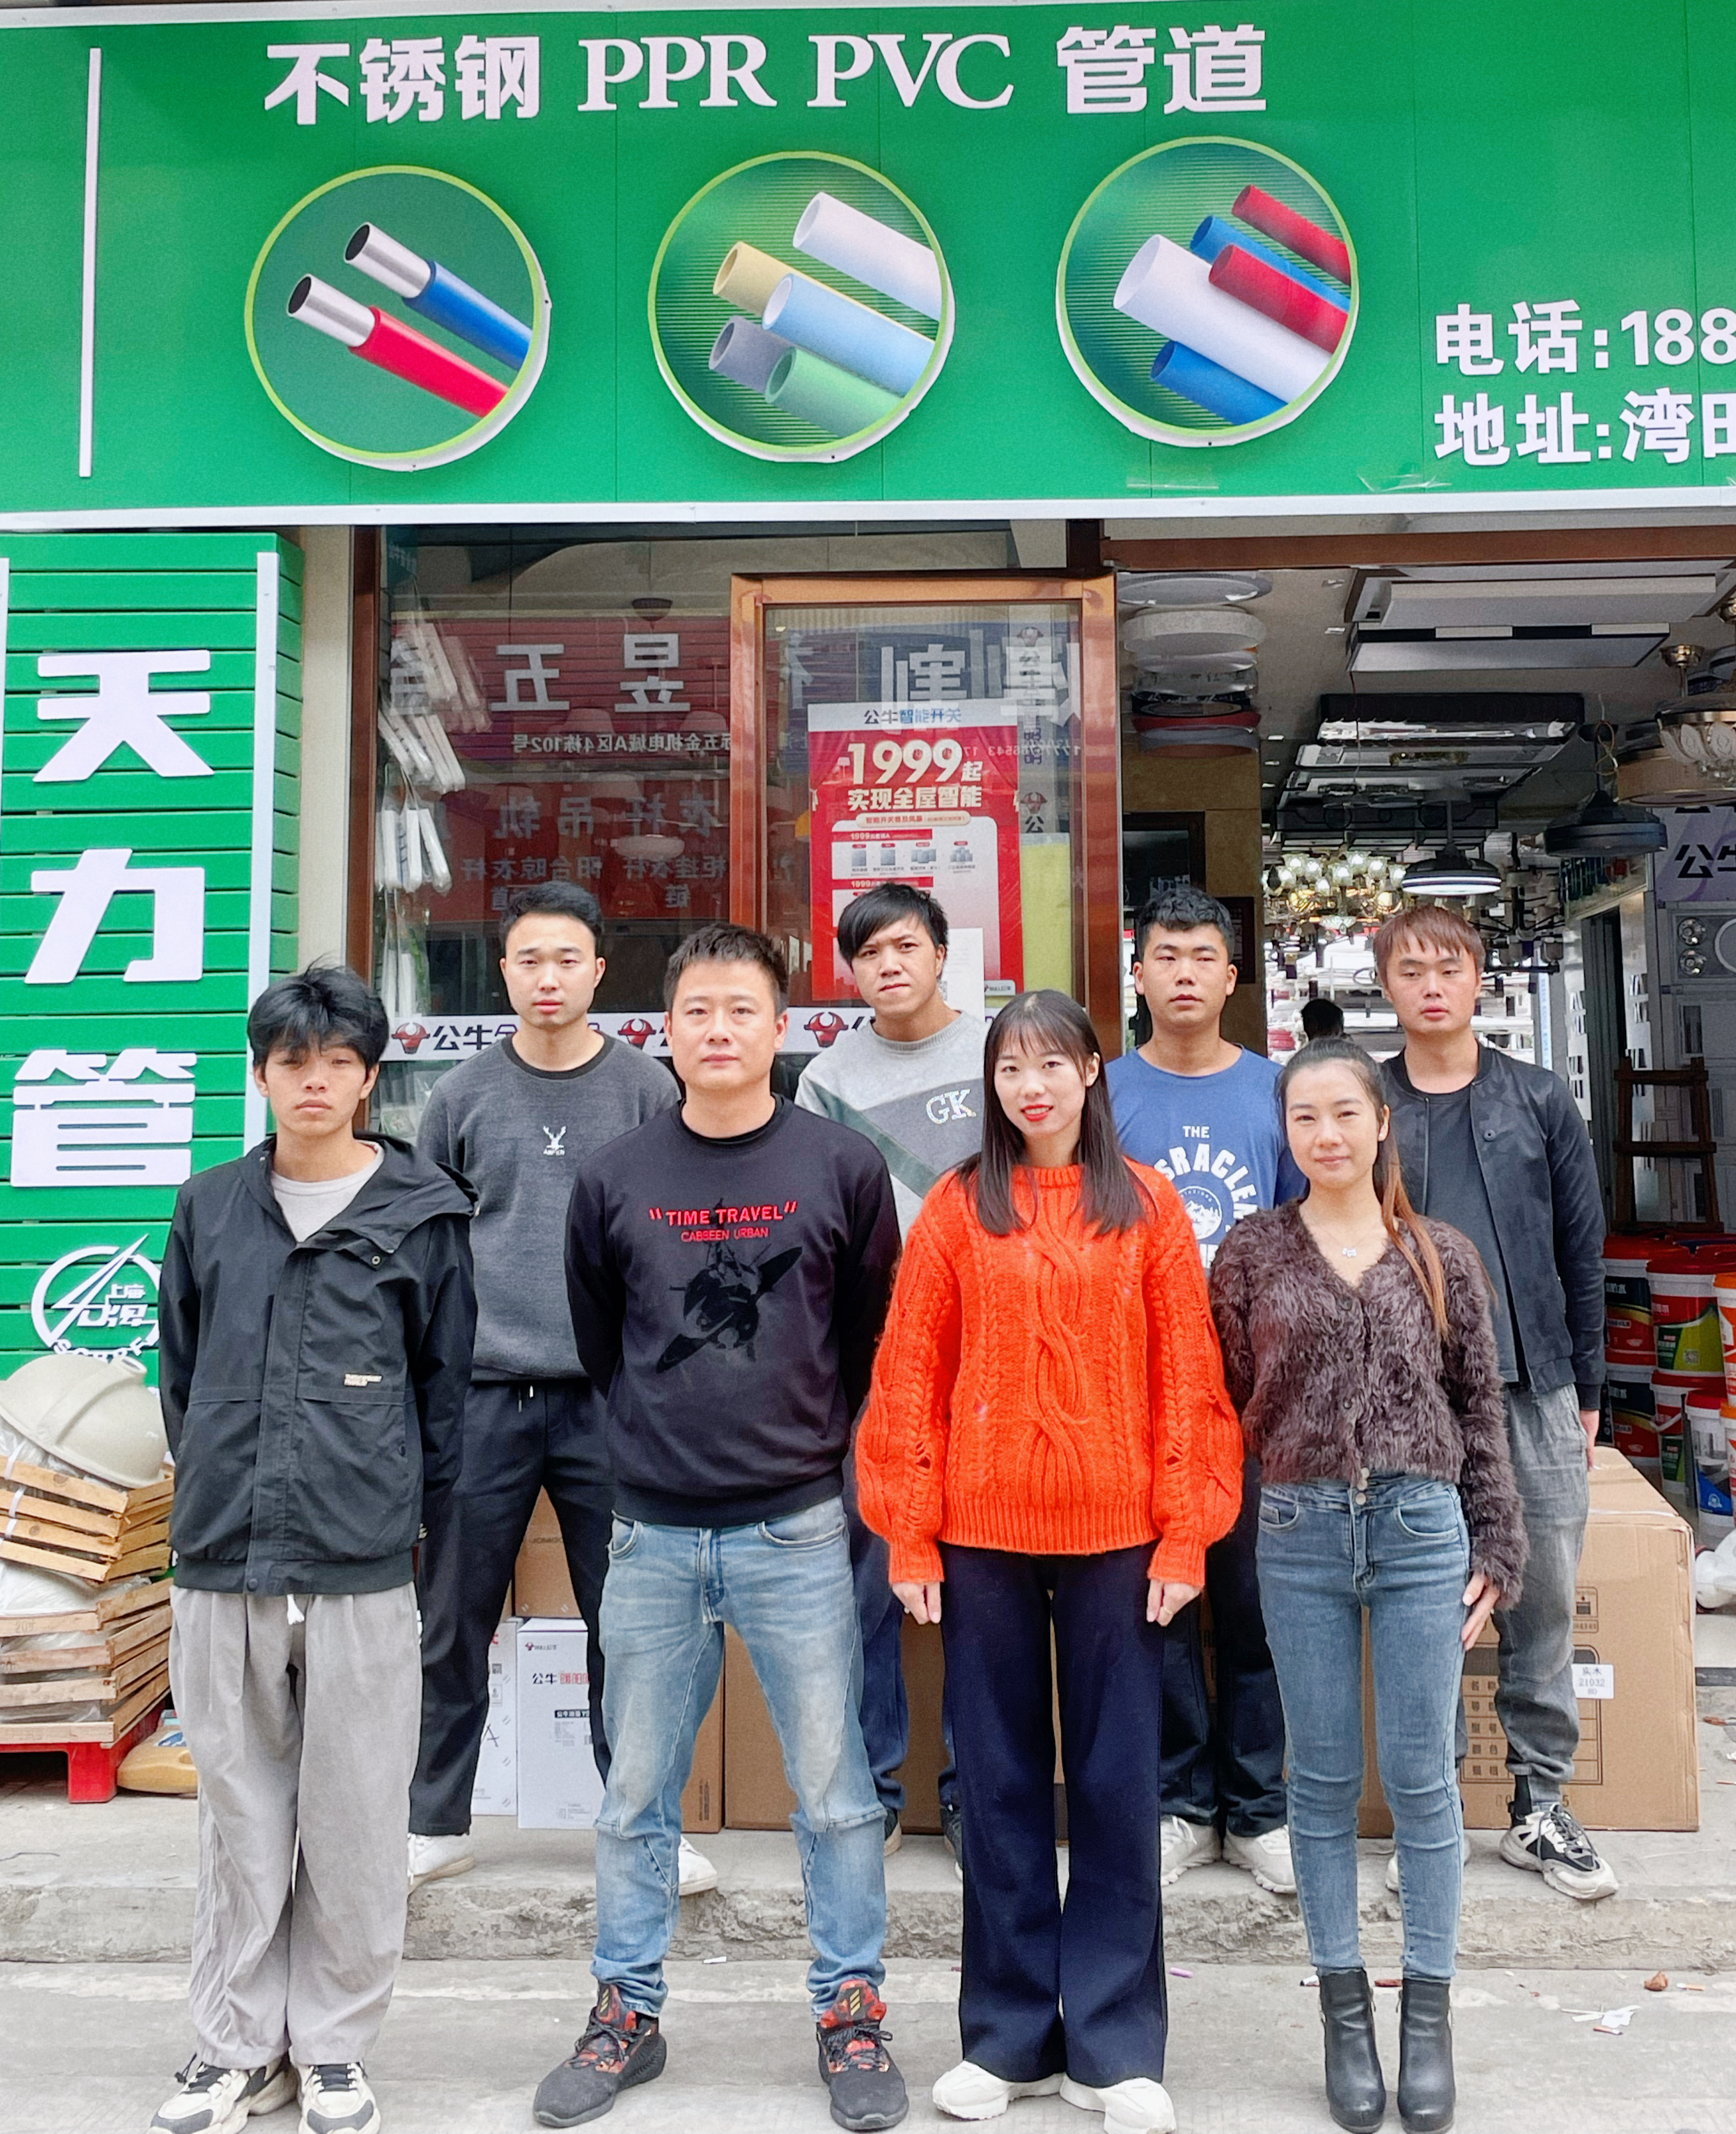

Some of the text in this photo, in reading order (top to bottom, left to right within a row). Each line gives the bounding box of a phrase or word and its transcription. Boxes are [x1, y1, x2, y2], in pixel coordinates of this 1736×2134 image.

[265, 24, 1266, 125] 不锈钢 PPR PVC 管道
[864, 707, 962, 725] 公牛智能开关
[847, 786, 982, 812] 实现全屋智能
[926, 1089, 977, 1125] GK
[1183, 1125, 1210, 1139] THE
[1579, 1677, 1605, 1687] 21032
